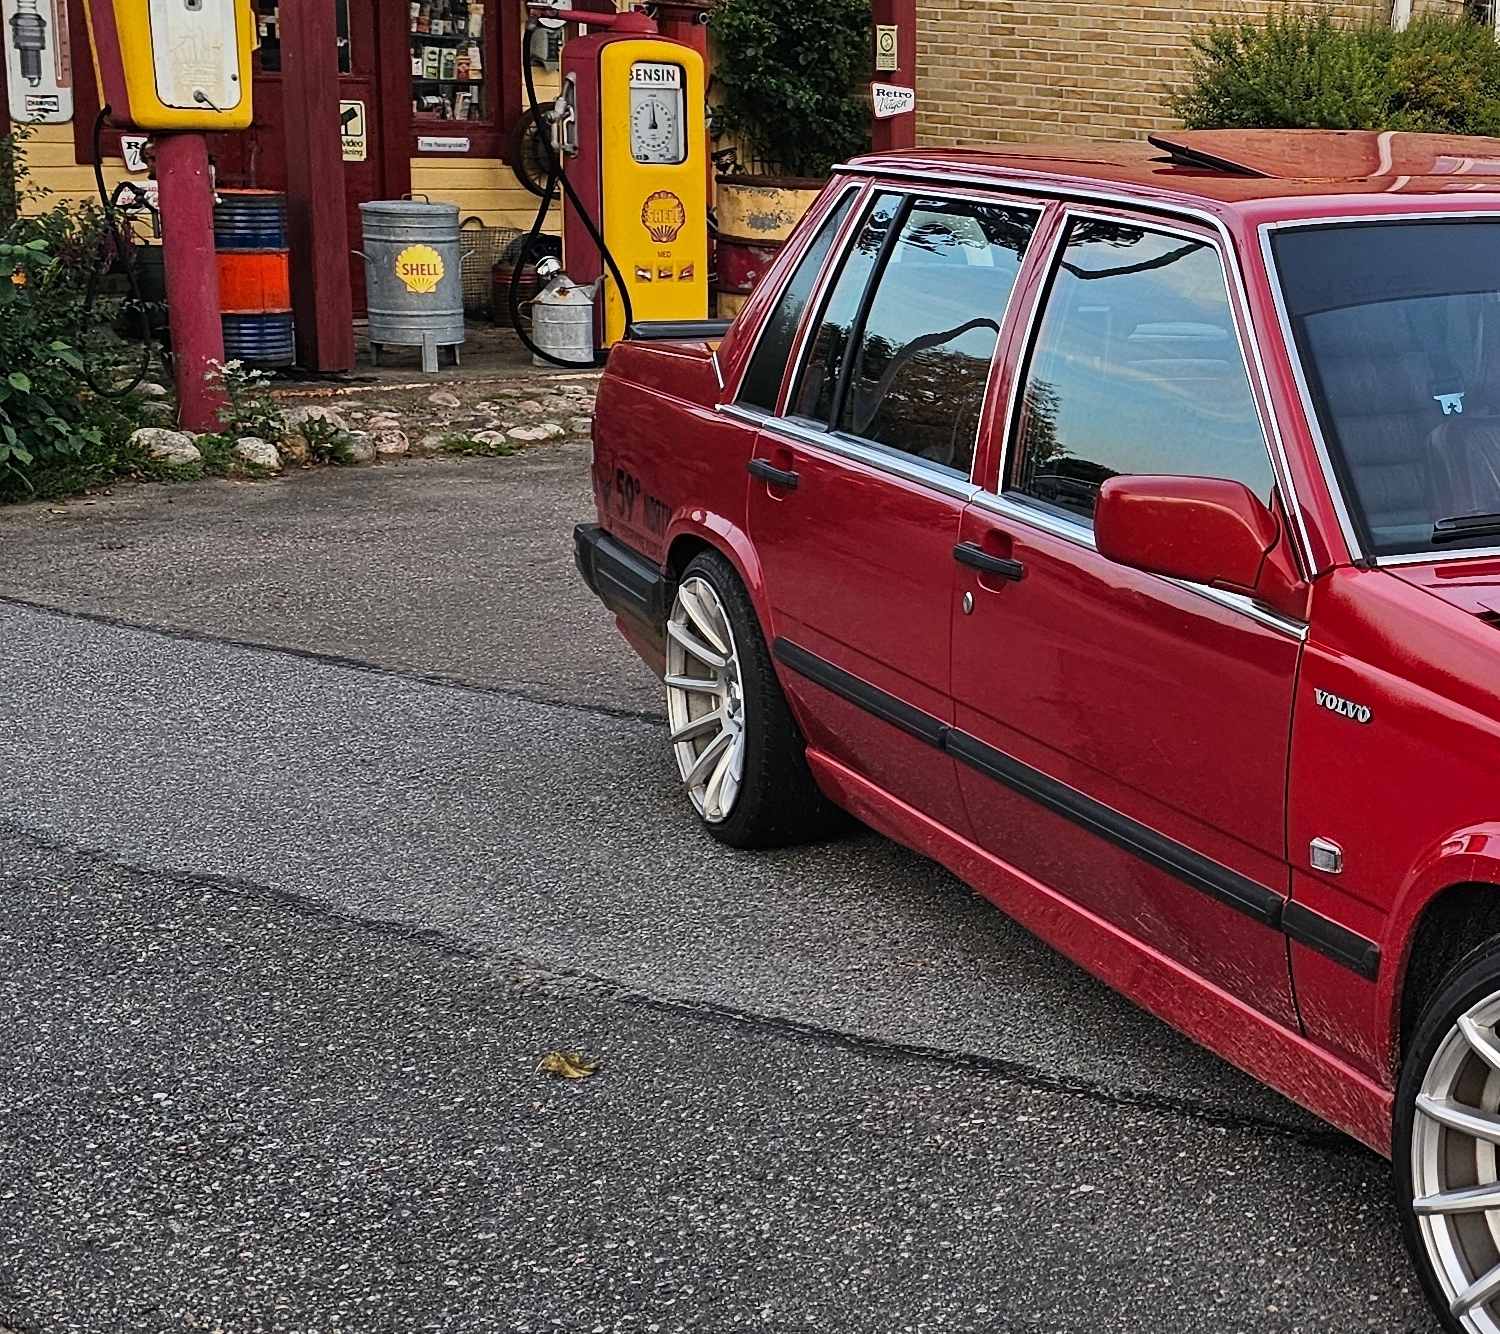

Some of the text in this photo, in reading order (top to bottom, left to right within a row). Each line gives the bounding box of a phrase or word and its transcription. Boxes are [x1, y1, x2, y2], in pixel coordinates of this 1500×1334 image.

[876, 88, 912, 99] Retro
[402, 263, 439, 276] SHELL
[1314, 688, 1371, 724] VOLVO
